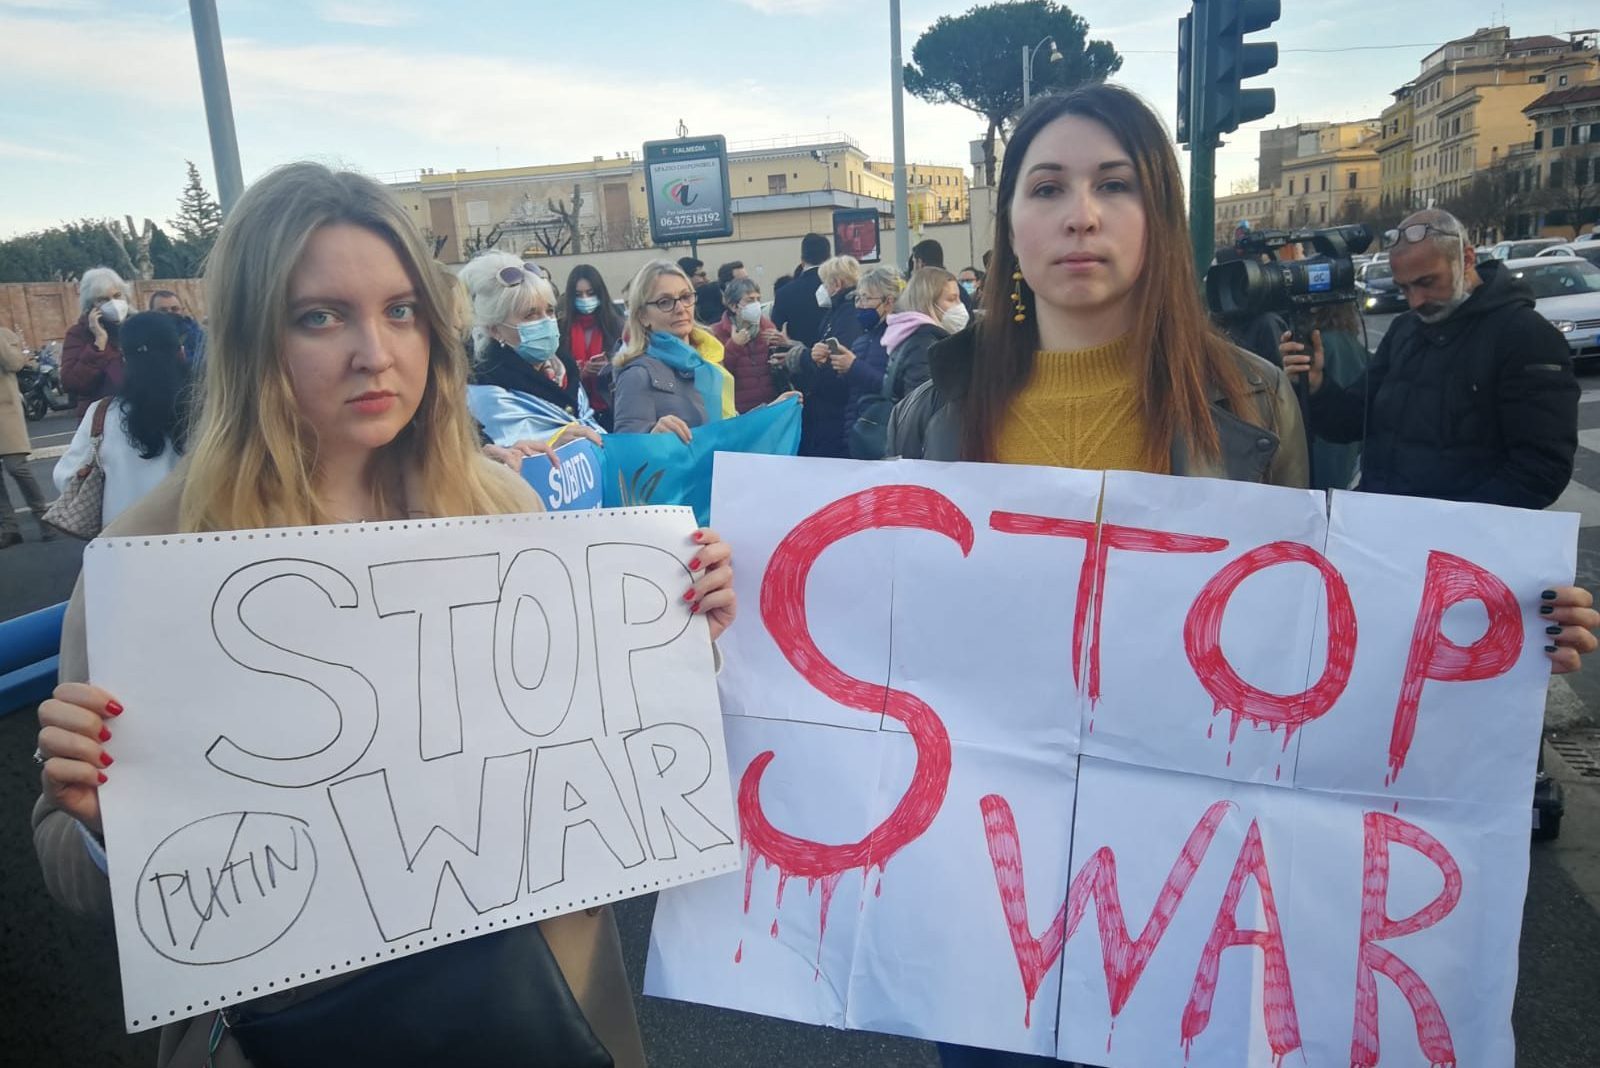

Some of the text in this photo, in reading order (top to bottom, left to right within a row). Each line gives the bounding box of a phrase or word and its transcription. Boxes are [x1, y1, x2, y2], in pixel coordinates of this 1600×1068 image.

[660, 212, 721, 227] 06.37518192
[548, 452, 594, 509] SUBITO
[205, 541, 696, 788] STOP
[737, 483, 1526, 882] STOP
[149, 825, 299, 947] PUTIN
[327, 722, 735, 943] WAR
[980, 794, 1464, 1067] WAR
